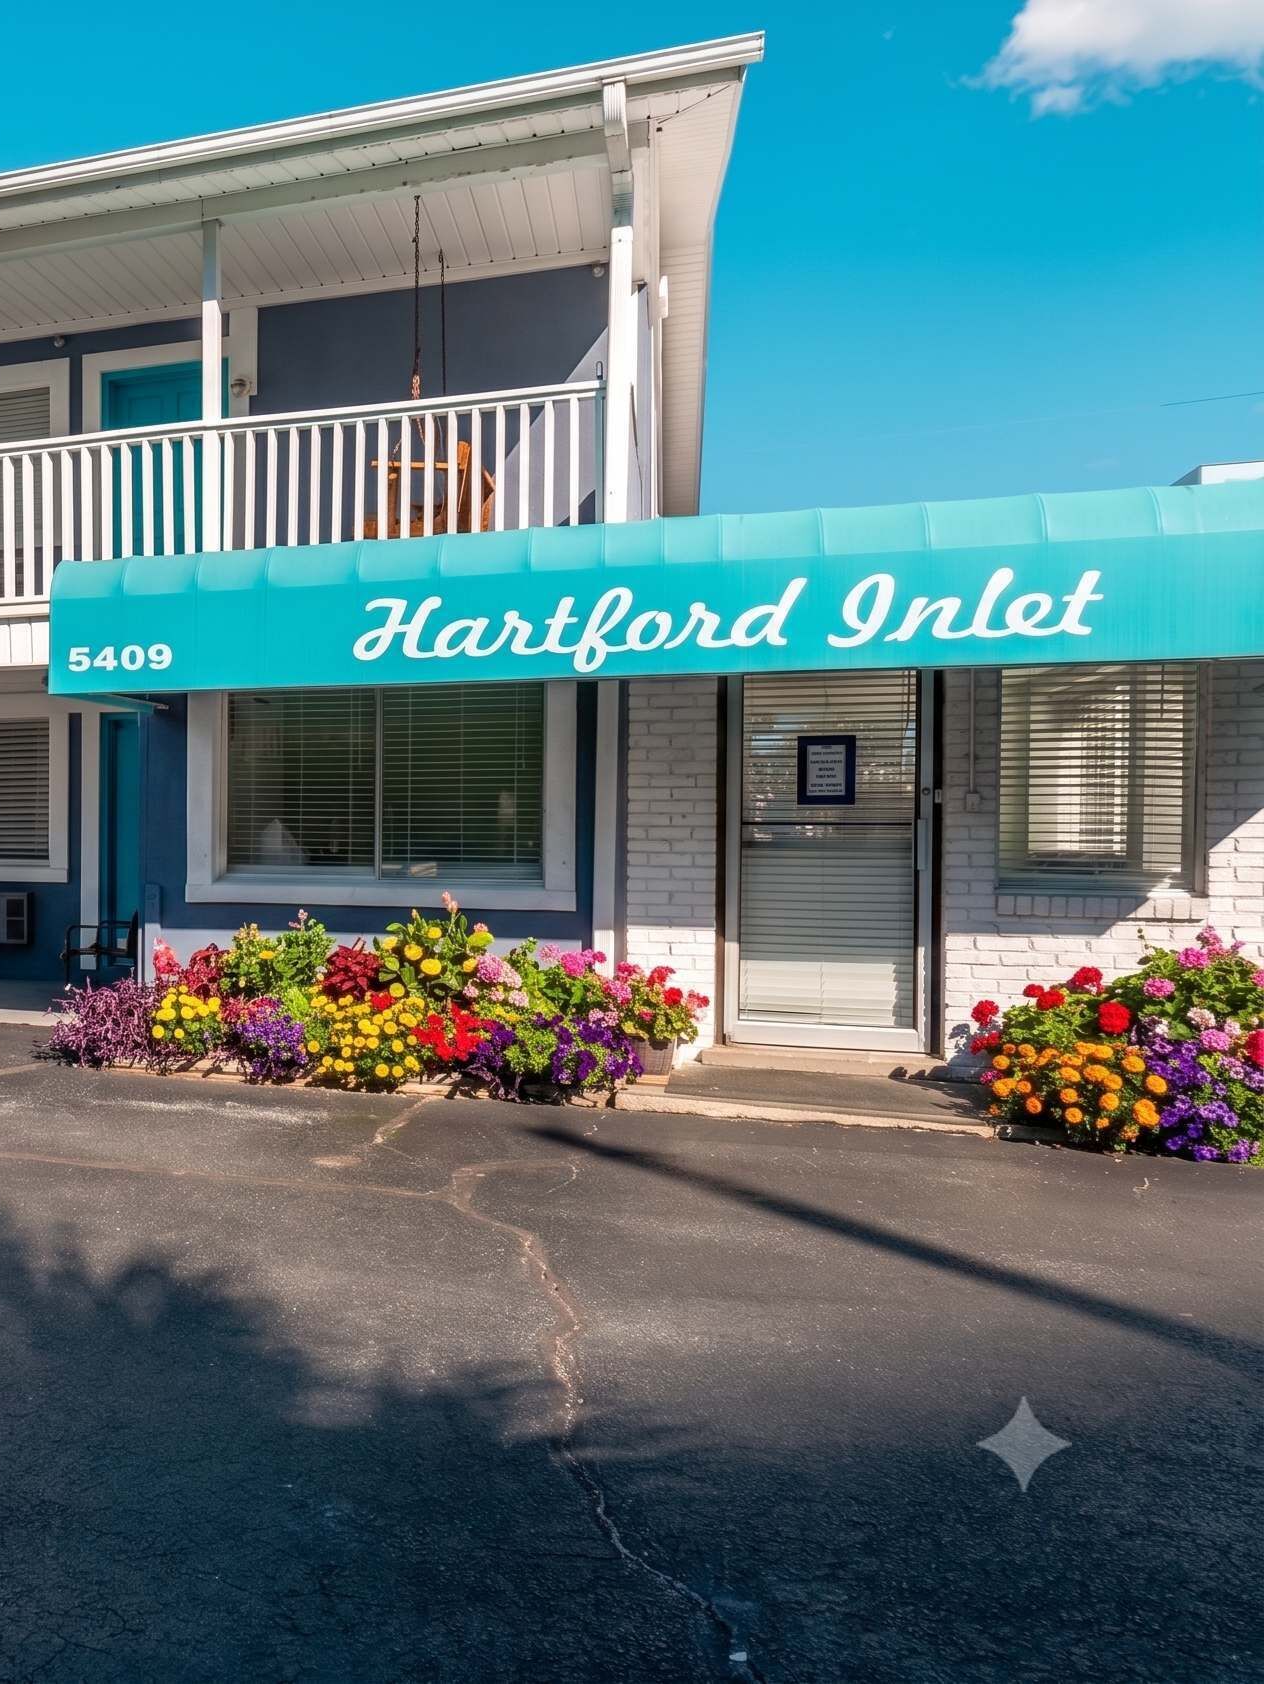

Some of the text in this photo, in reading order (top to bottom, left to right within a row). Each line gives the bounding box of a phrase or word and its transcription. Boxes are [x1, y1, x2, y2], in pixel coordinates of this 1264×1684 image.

[352, 567, 1104, 673] Hartford Inlet
[68, 643, 173, 672] 5409
